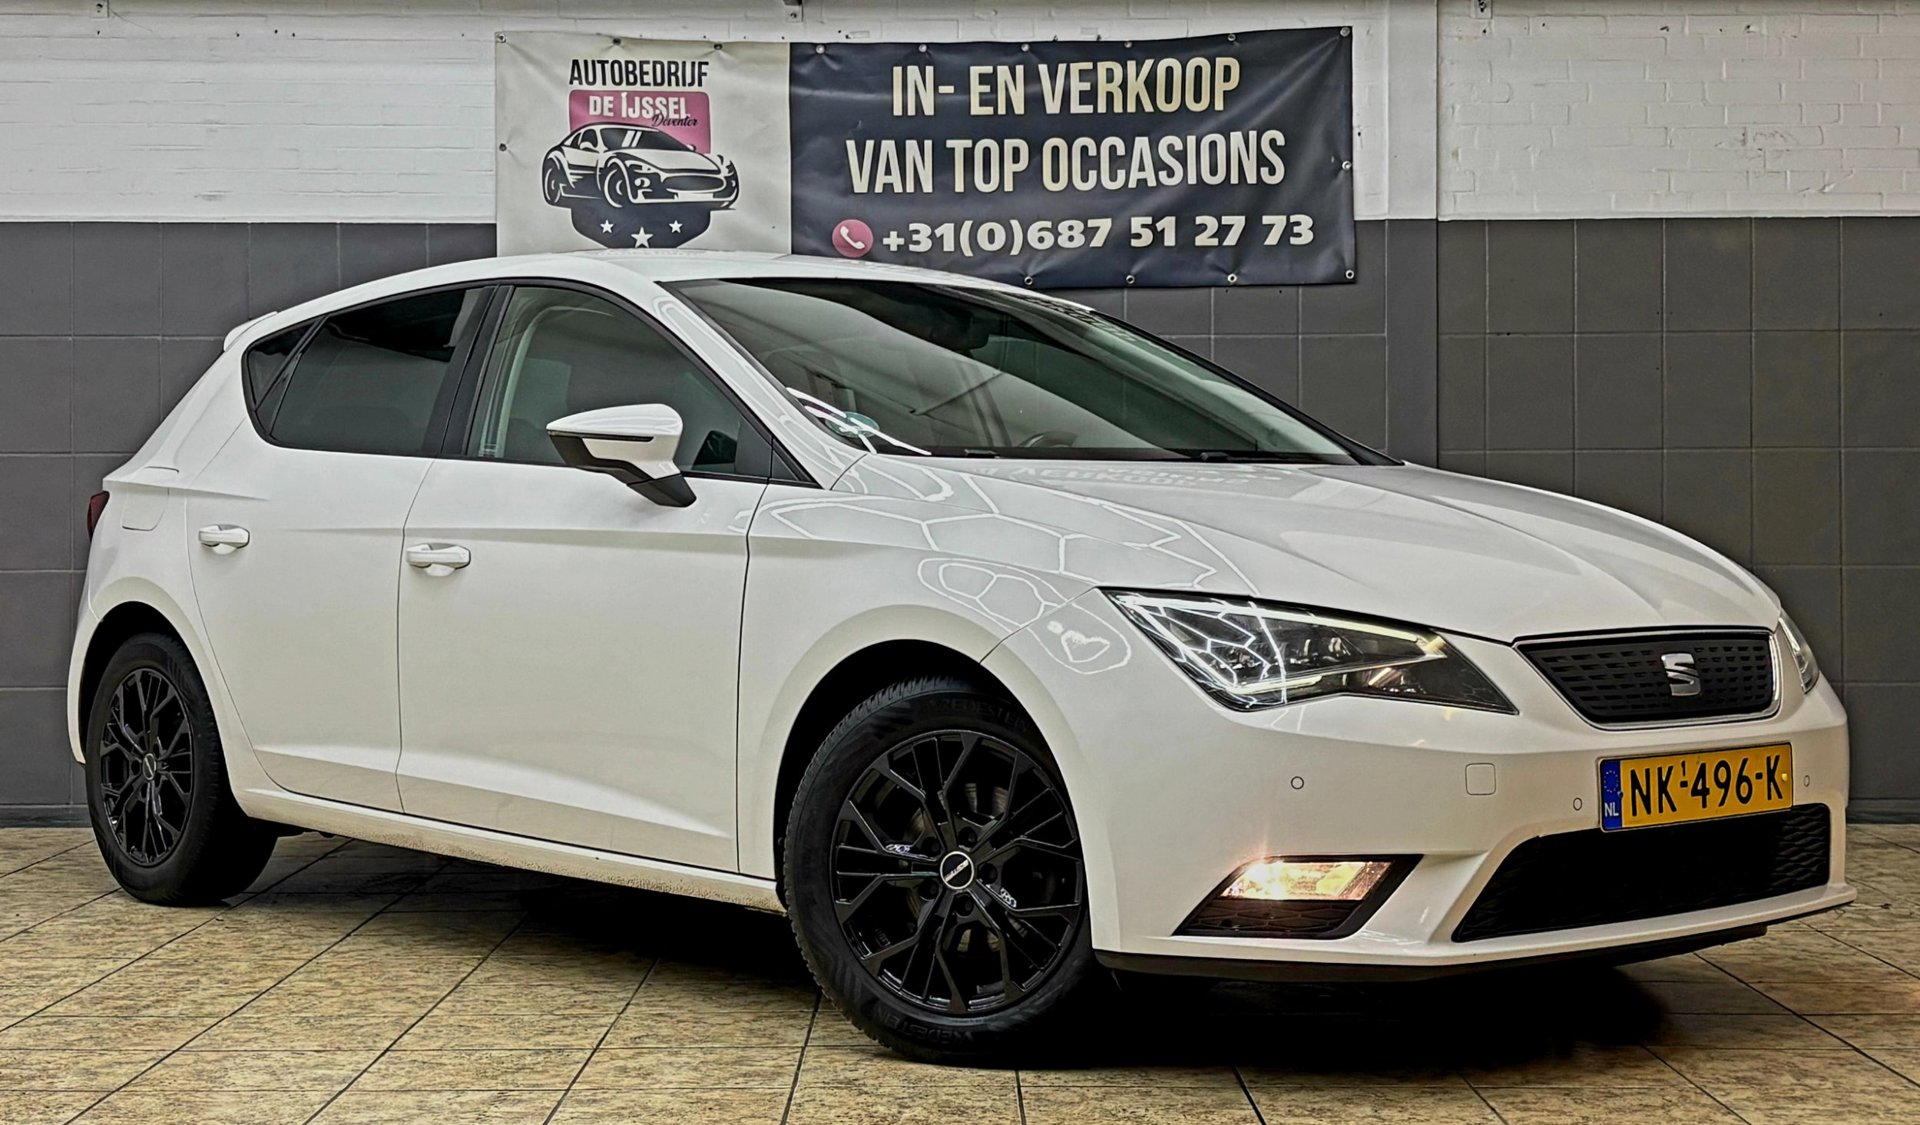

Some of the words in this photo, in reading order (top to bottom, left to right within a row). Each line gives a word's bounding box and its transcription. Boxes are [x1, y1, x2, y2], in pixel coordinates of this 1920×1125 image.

[569, 59, 710, 87] AUTOBEDRIJF
[892, 64, 954, 117] IN-
[969, 64, 1025, 116] EN
[1038, 56, 1241, 116] VERKOOP
[588, 95, 615, 117] DE
[651, 113, 699, 128] Deventer
[845, 138, 934, 194] VAN
[945, 137, 1030, 193] TOP
[1041, 129, 1287, 192] OCCASIONS
[881, 216, 1113, 257] +31(0)687
[1129, 216, 1178, 248] 51
[1194, 214, 1247, 247] 27
[1261, 213, 1315, 246] 73
[1604, 802, 1620, 818] NL
[1630, 754, 1784, 817] NK-496-K
